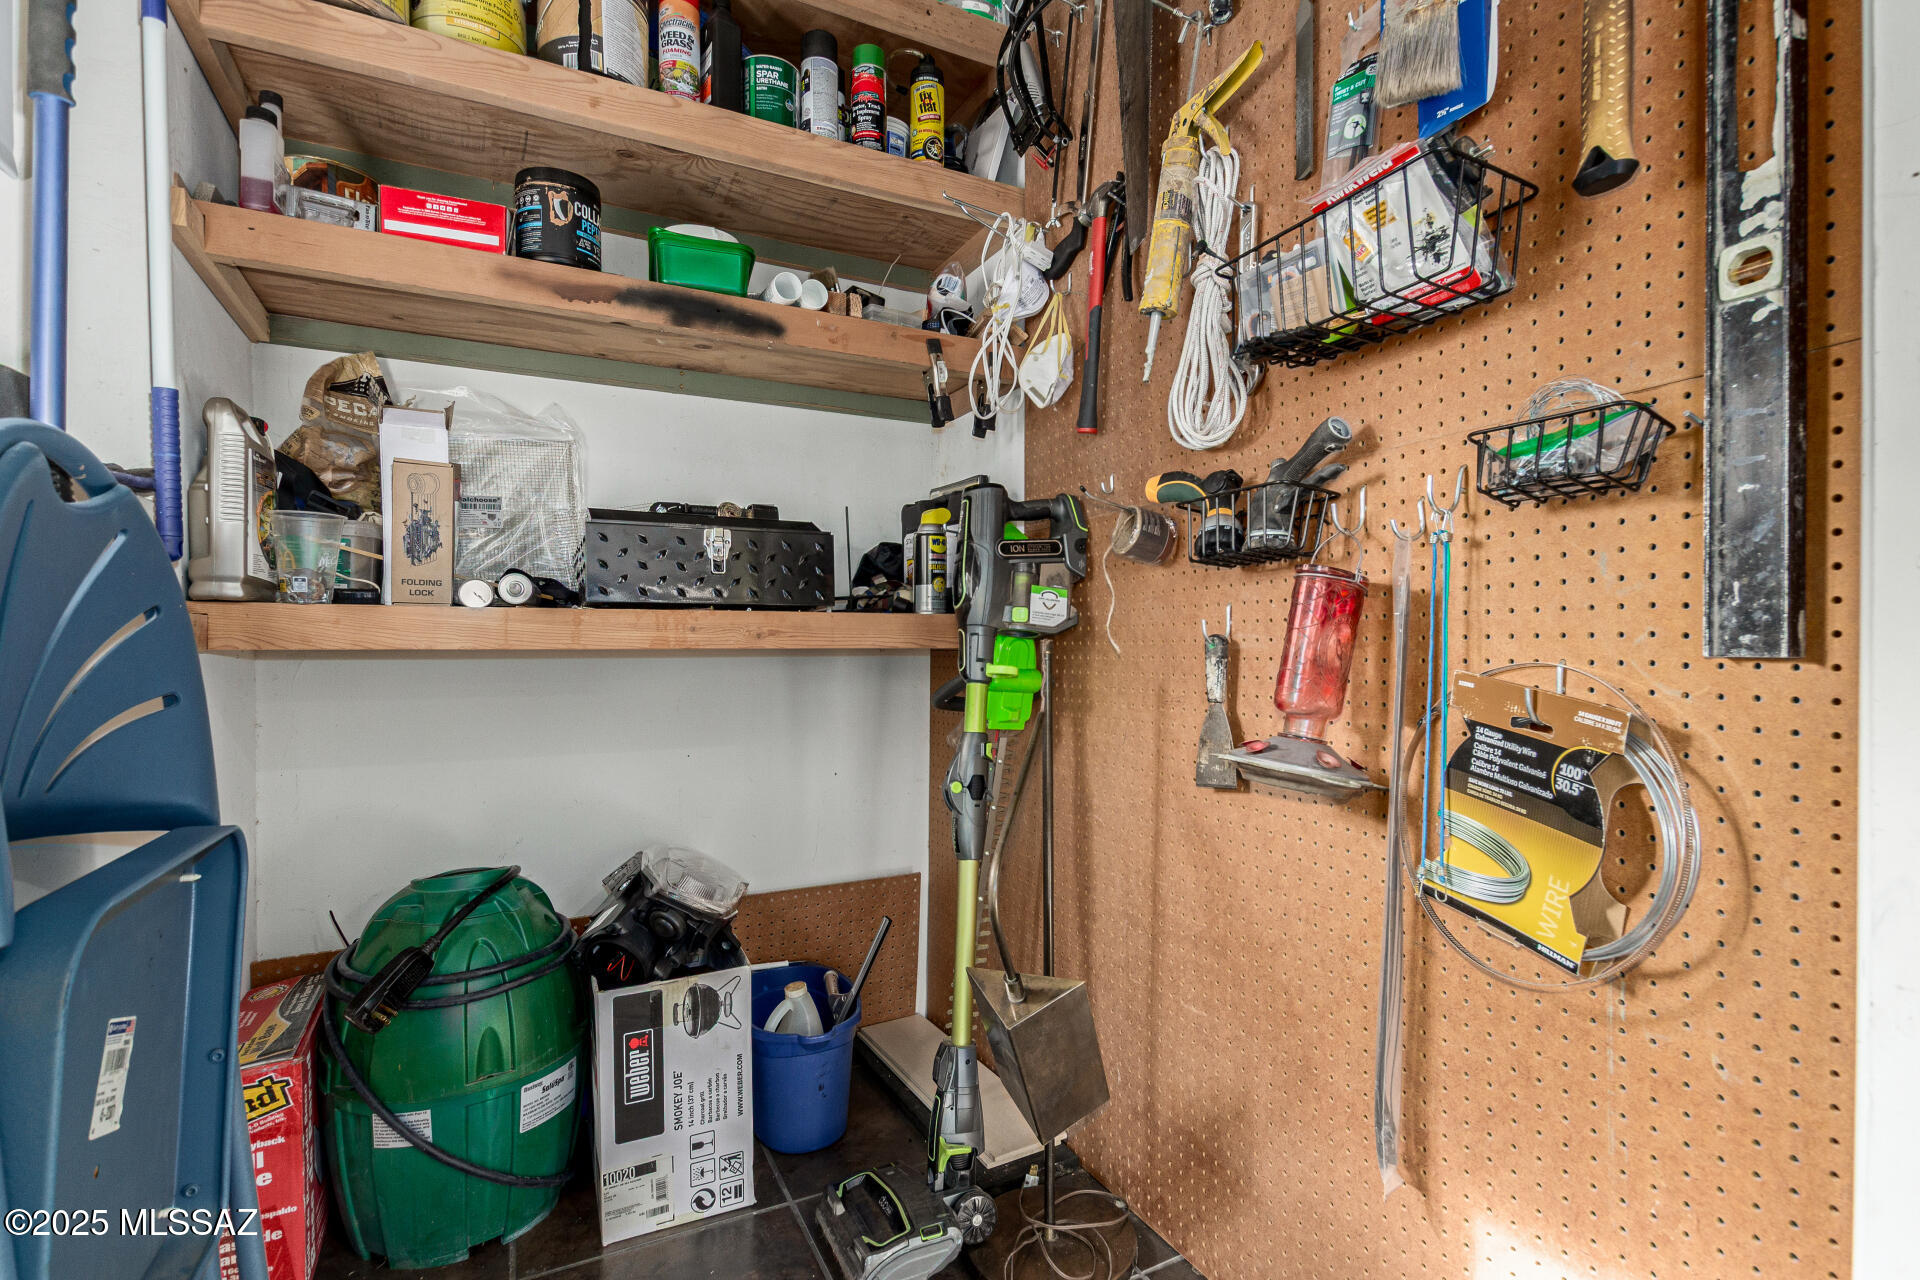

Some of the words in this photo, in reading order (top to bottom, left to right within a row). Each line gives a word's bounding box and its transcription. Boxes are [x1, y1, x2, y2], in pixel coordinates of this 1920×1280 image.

[661, 31, 687, 40] WEED
[661, 40, 693, 51] GRASS
[662, 48, 692, 56] FOAMING
[756, 70, 779, 79] SPAR
[756, 78, 788, 88] URETHANE
[919, 91, 933, 100] fix
[919, 102, 937, 113] flat
[1483, 729, 1503, 741] Gauge
[1473, 742, 1494, 753] Calibre
[1474, 732, 1504, 747] Galvanized
[1503, 741, 1522, 754] Utility
[1521, 747, 1538, 758] Wire
[1471, 758, 1491, 769] Calibre
[1488, 754, 1518, 770] Polyvalent
[1518, 763, 1548, 779] Galvanisé
[1558, 762, 1584, 780] 100
[1469, 765, 1494, 778] Alambre
[1517, 781, 1554, 799] Galvanizado
[1553, 777, 1581, 796] 30.5
[1536, 874, 1570, 939] WIRE
[1537, 944, 1578, 970] HILLMAN
[630, 1049, 650, 1100] weber
[674, 1094, 684, 1131] SMOKEY
[688, 1118, 694, 1127] 14
[604, 1166, 636, 1187] 10020
[721, 1186, 733, 1204] 12
